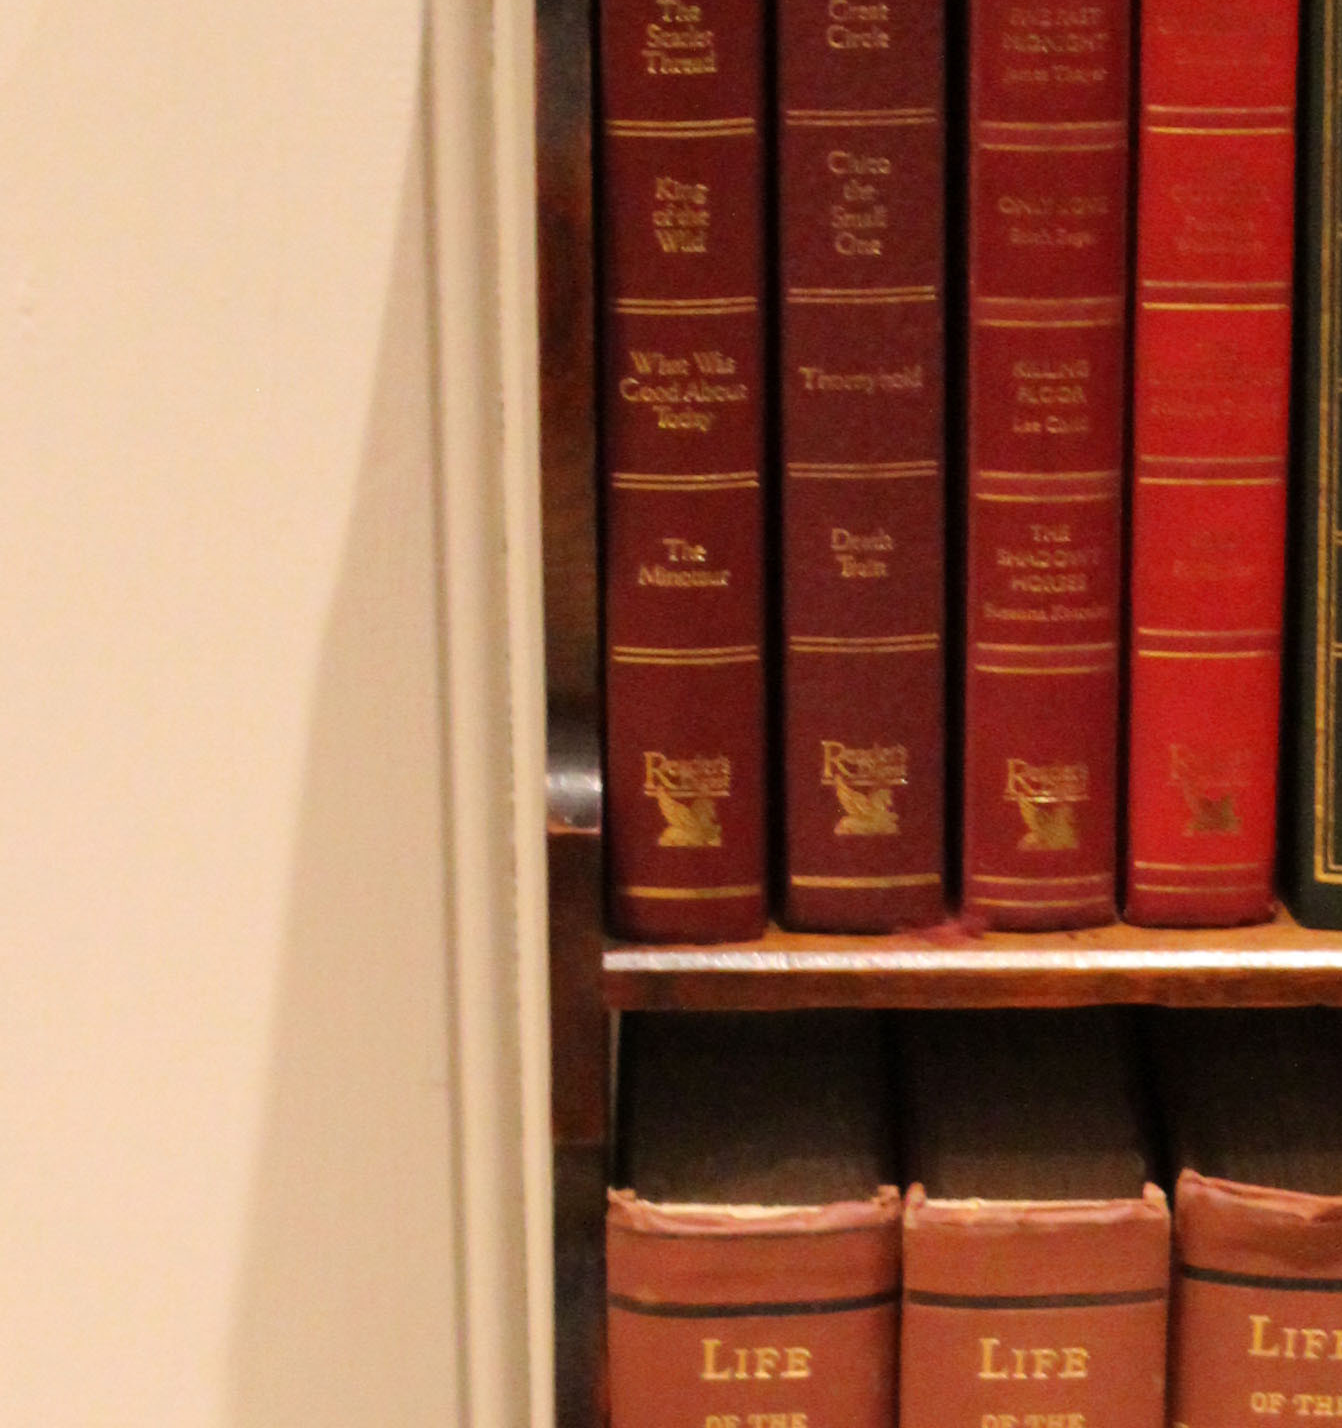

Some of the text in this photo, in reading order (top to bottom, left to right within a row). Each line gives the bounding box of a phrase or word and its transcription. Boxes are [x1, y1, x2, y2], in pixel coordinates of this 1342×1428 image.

[701, 1338, 812, 1381] LIFE
[978, 1337, 1089, 1380] LIFE
[1250, 1392, 1288, 1415] OF
